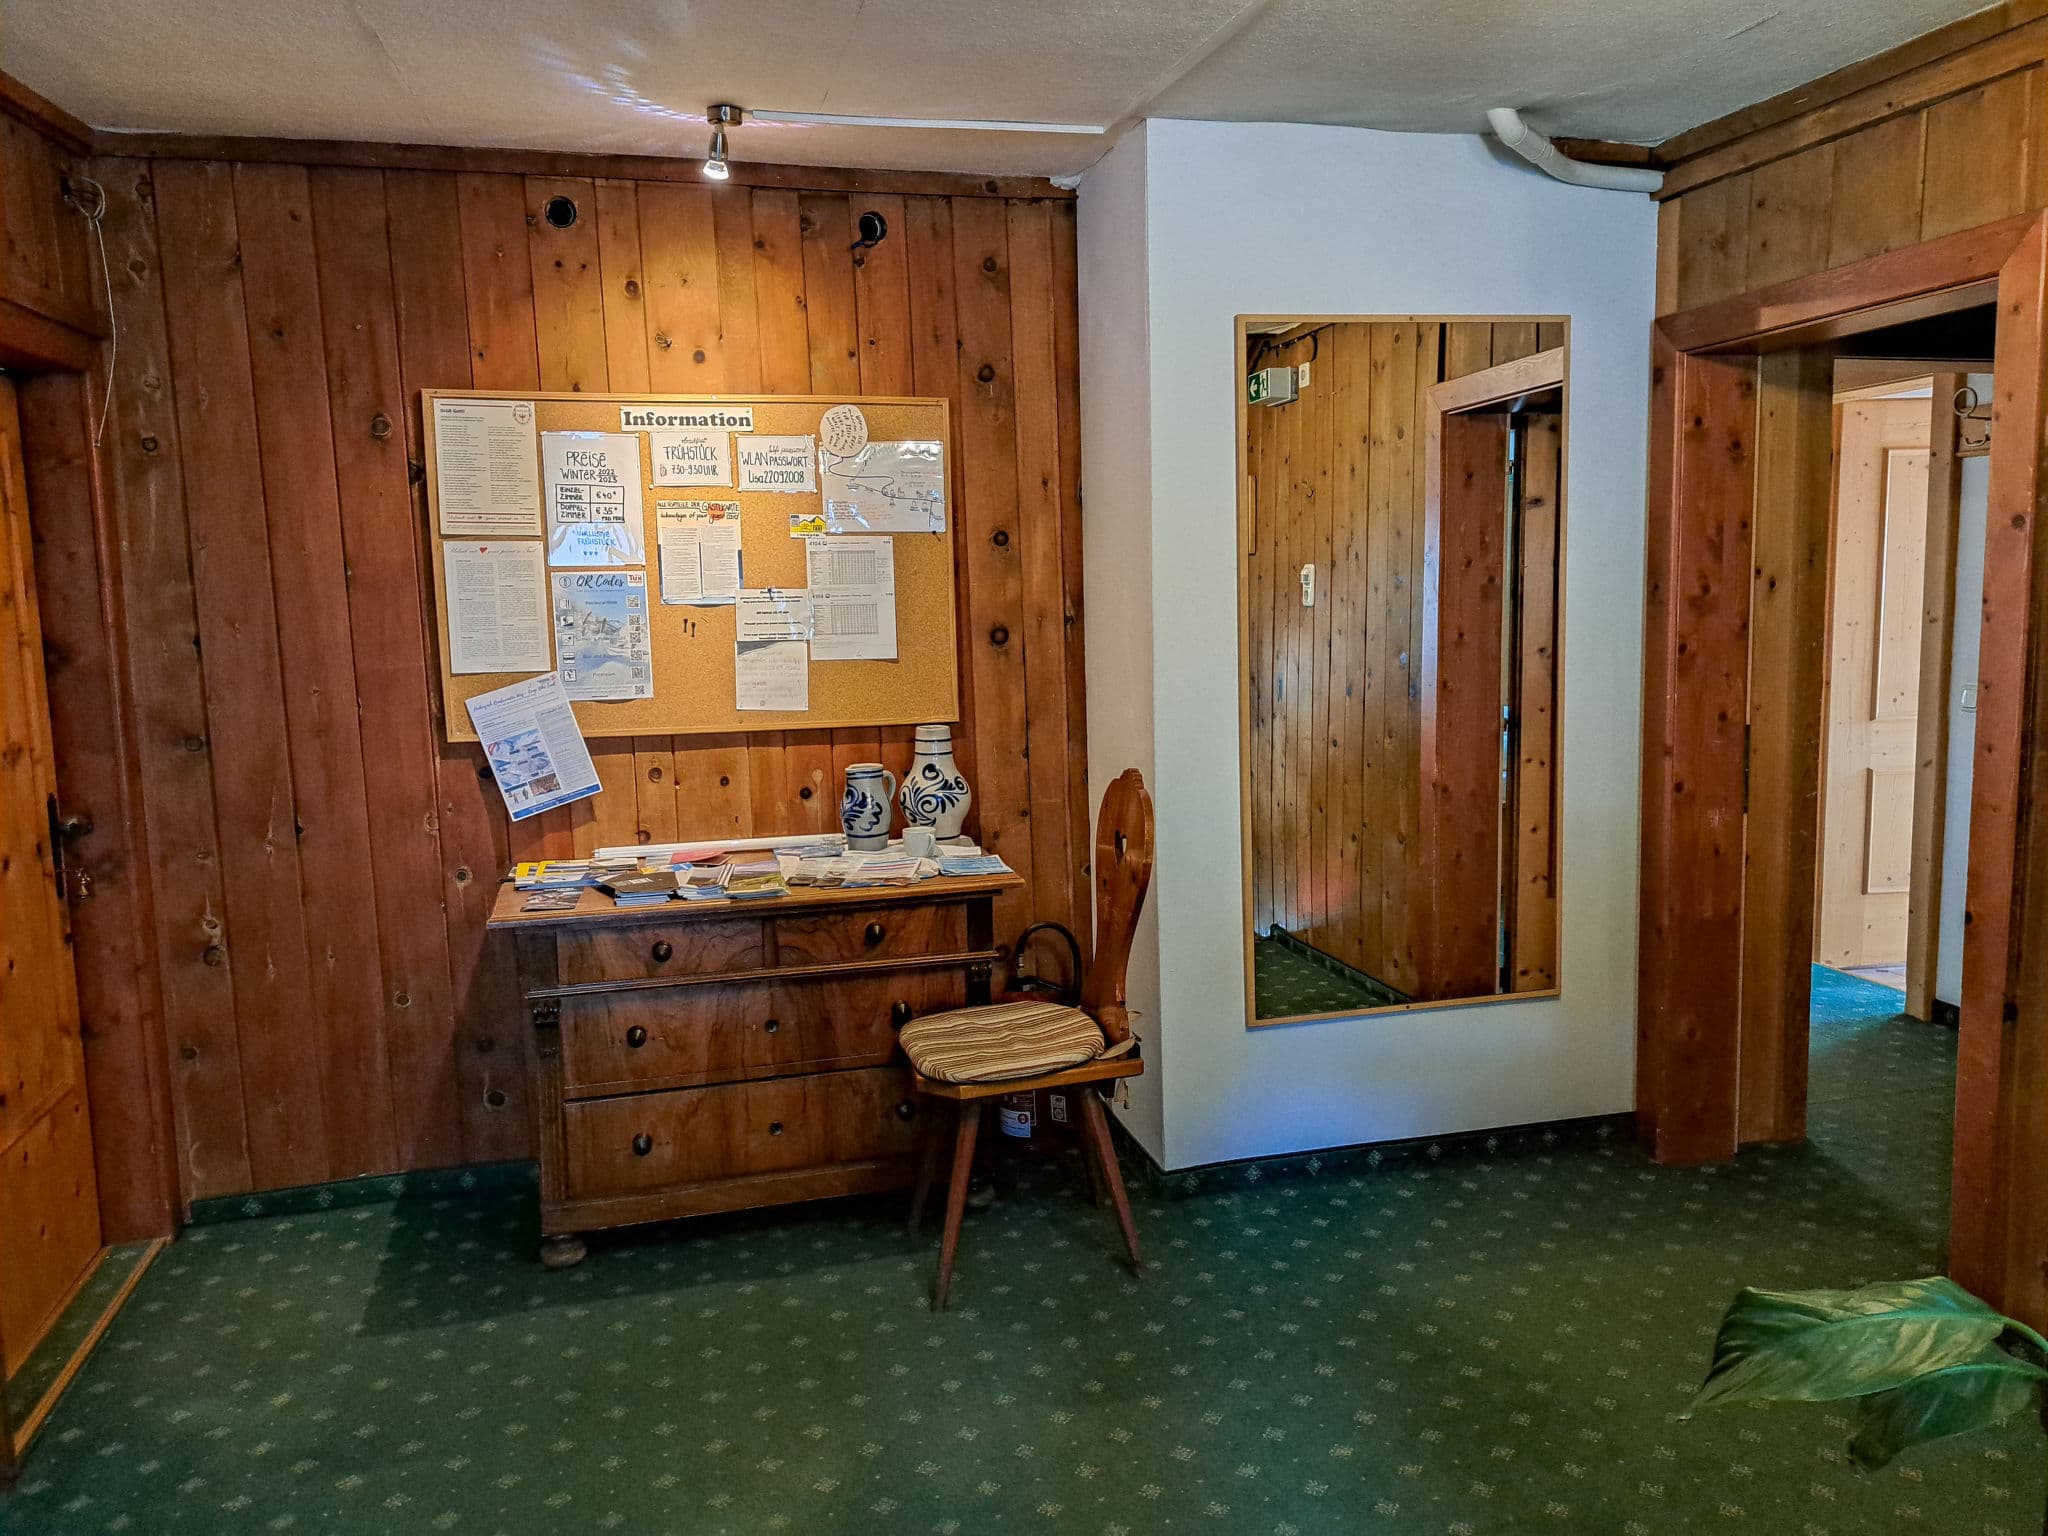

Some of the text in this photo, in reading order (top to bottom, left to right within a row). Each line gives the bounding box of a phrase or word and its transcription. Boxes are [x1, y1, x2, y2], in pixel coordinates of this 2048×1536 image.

[623, 411, 752, 427] Information
[741, 451, 808, 468] WLAN PASSWORT
[576, 574, 624, 589] QR Codes
